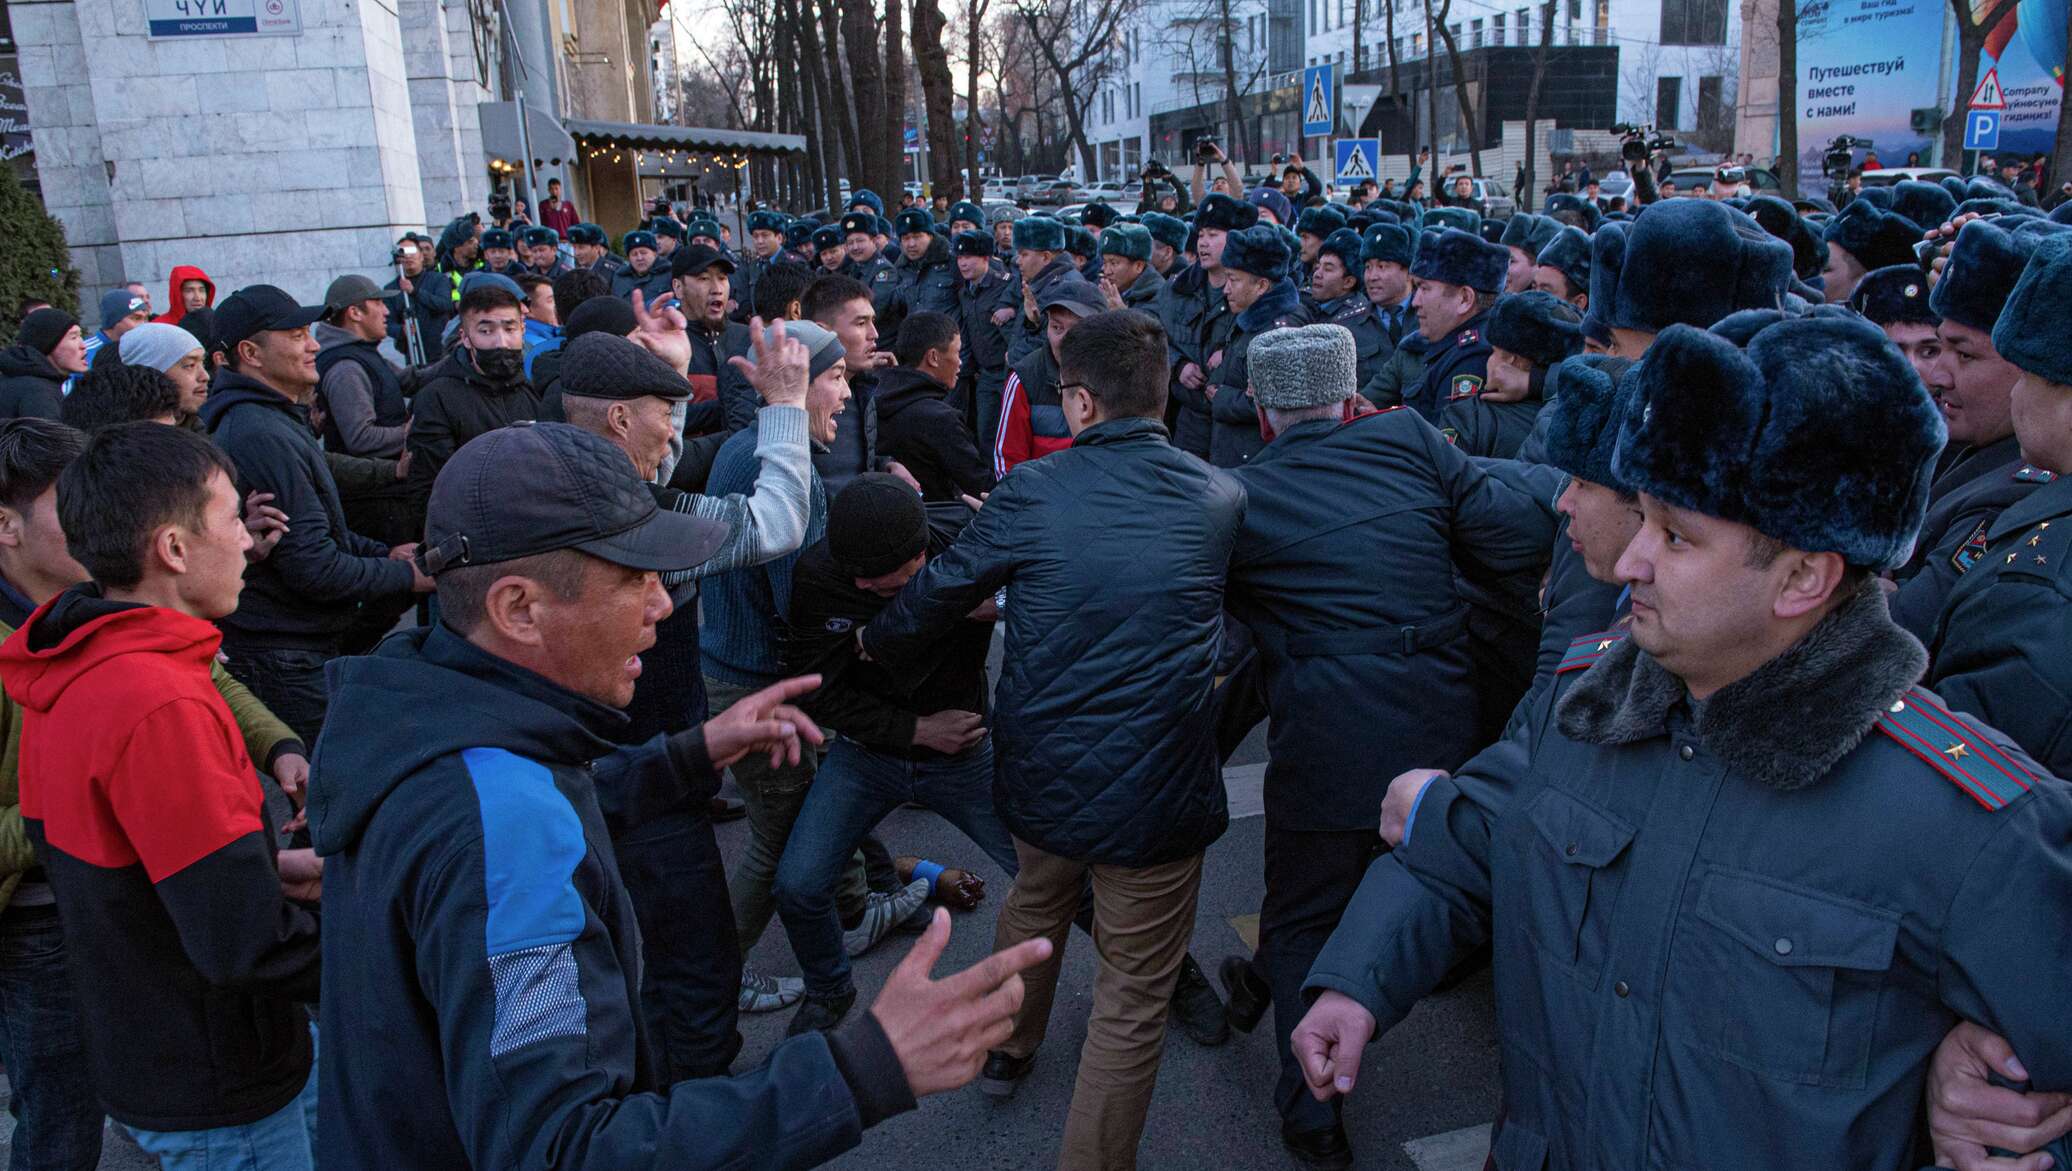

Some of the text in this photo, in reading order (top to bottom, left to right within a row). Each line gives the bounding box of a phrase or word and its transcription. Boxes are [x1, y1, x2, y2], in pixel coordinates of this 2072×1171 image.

[179, 21, 229, 31] ПРОСПЕКТИ
[1809, 56, 1904, 82] Путешествуй
[1808, 85, 1854, 99] вместе
[2003, 86, 2050, 97] Company
[1806, 102, 1856, 118] с нами!
[1974, 116, 1993, 144] P
